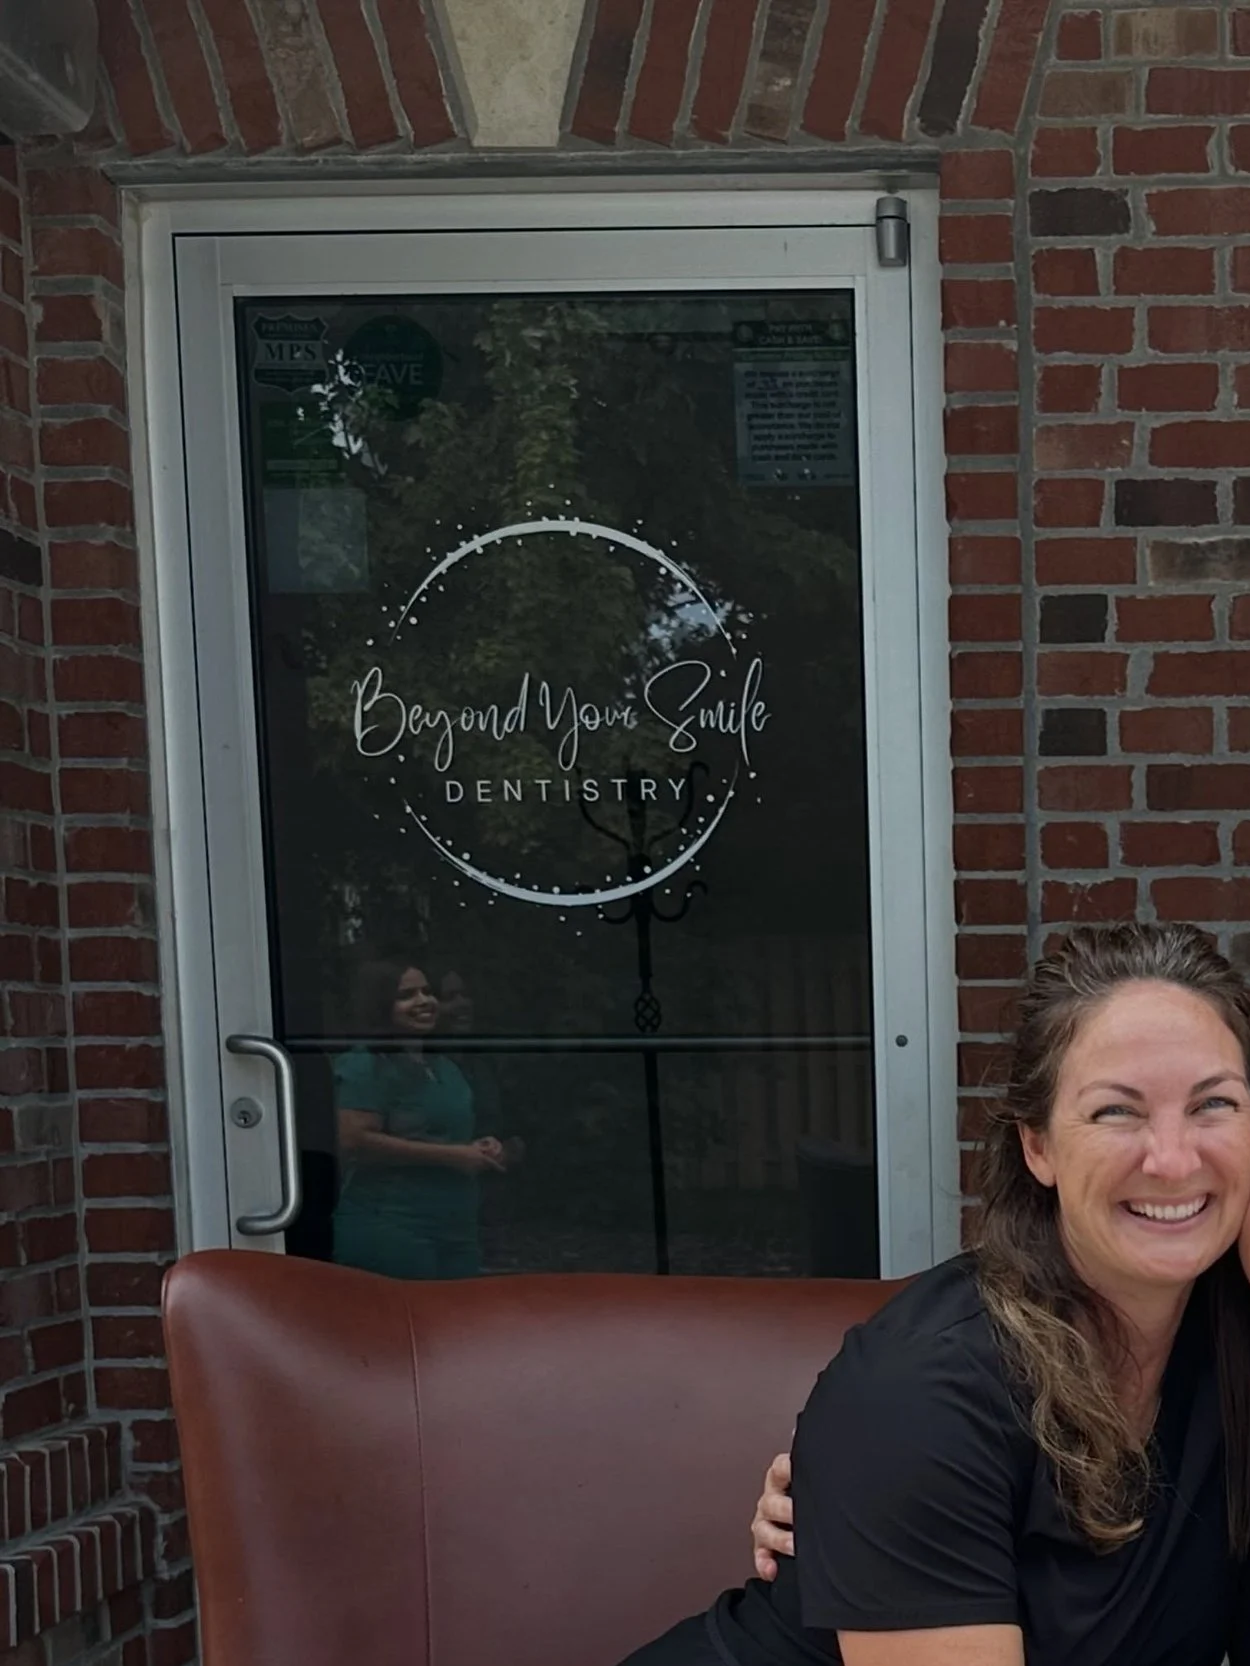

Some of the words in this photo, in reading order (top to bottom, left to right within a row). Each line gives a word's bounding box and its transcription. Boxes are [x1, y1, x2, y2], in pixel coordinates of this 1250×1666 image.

[349, 666, 531, 773] Beyond
[539, 680, 639, 772] Your
[643, 656, 772, 767] Smile
[445, 778, 689, 803] DENTISTRY
